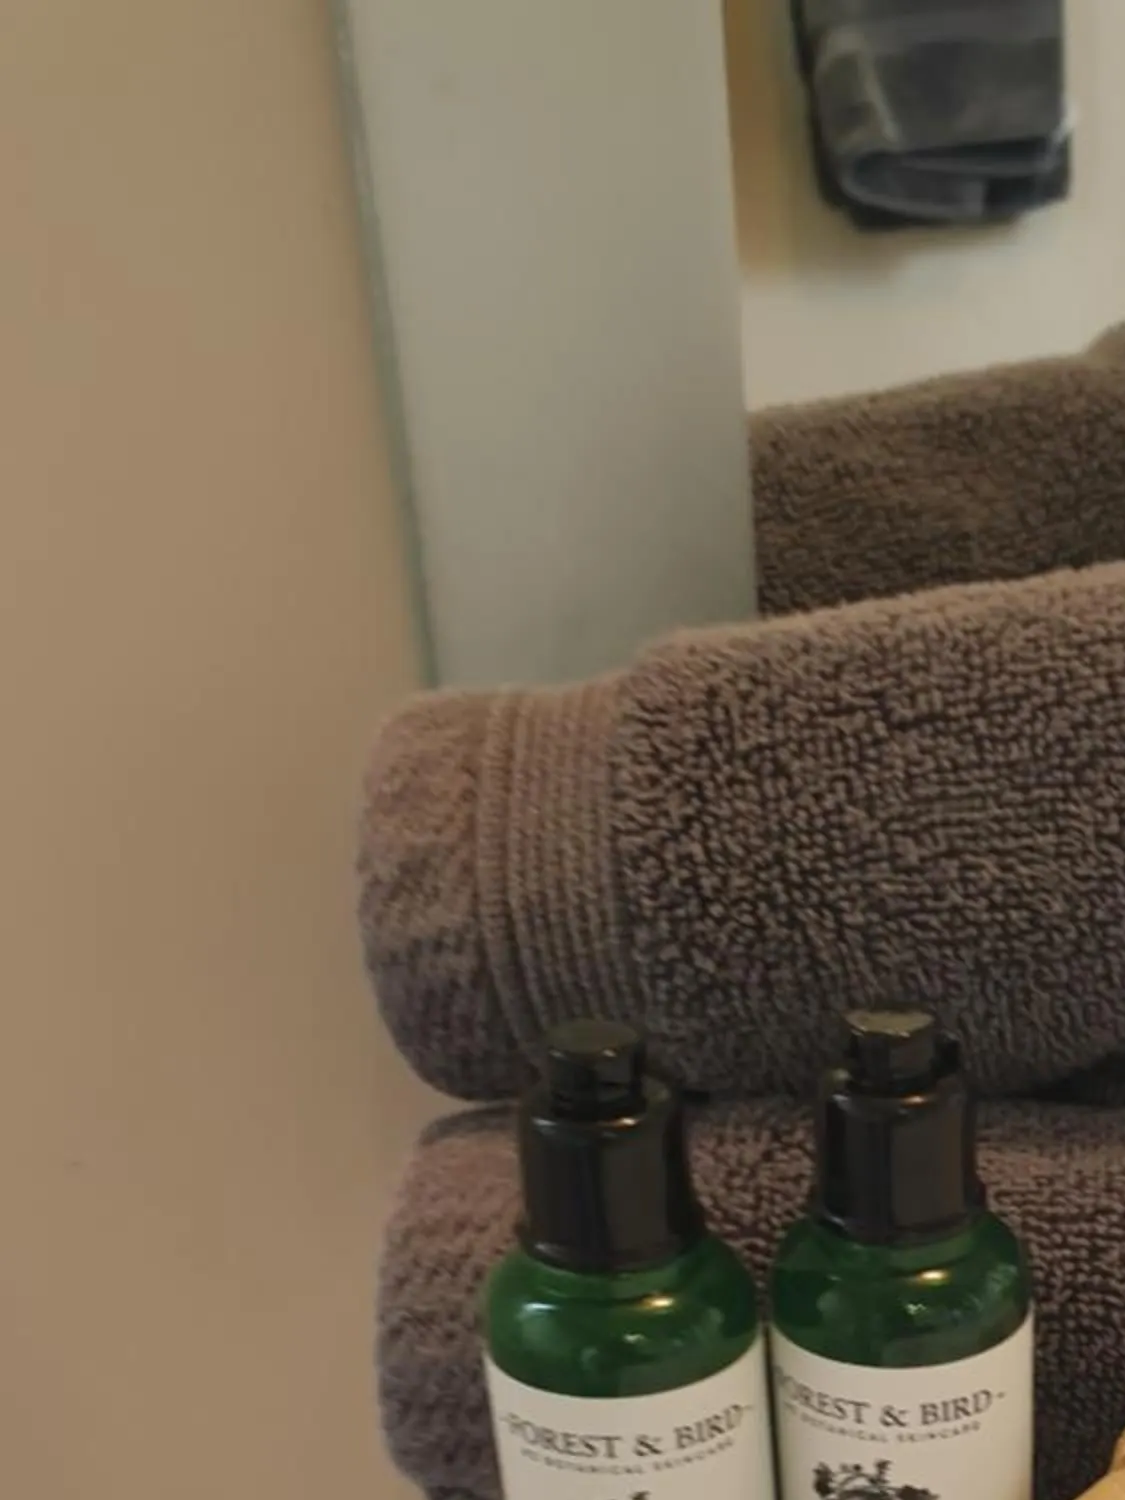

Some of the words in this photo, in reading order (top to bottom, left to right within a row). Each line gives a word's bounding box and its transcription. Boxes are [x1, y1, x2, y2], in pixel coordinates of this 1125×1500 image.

[879, 1405, 911, 1428] &
[896, 1420, 981, 1444] SKINCARE
[633, 1433, 663, 1457] &
